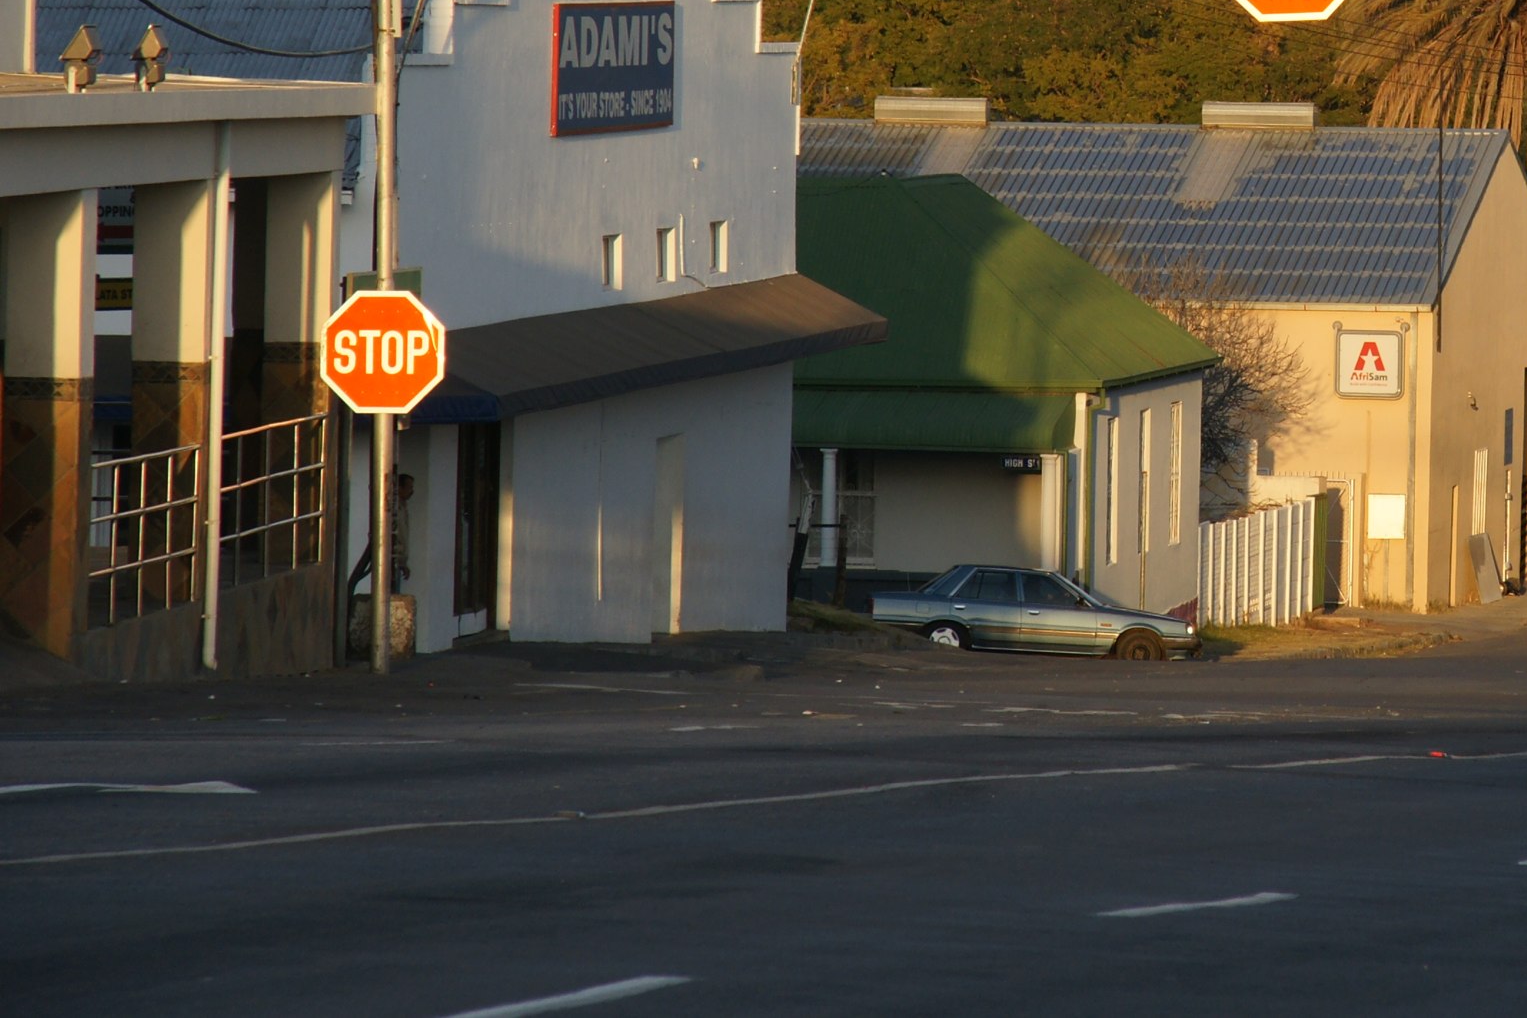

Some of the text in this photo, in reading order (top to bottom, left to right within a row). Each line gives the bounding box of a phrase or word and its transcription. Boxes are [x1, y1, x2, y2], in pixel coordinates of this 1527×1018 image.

[560, 12, 673, 68] ADAMI'S
[558, 94, 574, 120] IT'S
[575, 92, 598, 119] YOUR
[599, 91, 626, 118] STORE
[630, 89, 654, 116] SINCE
[656, 88, 672, 113] 1904
[333, 329, 430, 375] STOP
[1350, 372, 1388, 381] AfriSam
[1004, 458, 1024, 468] HIGH
